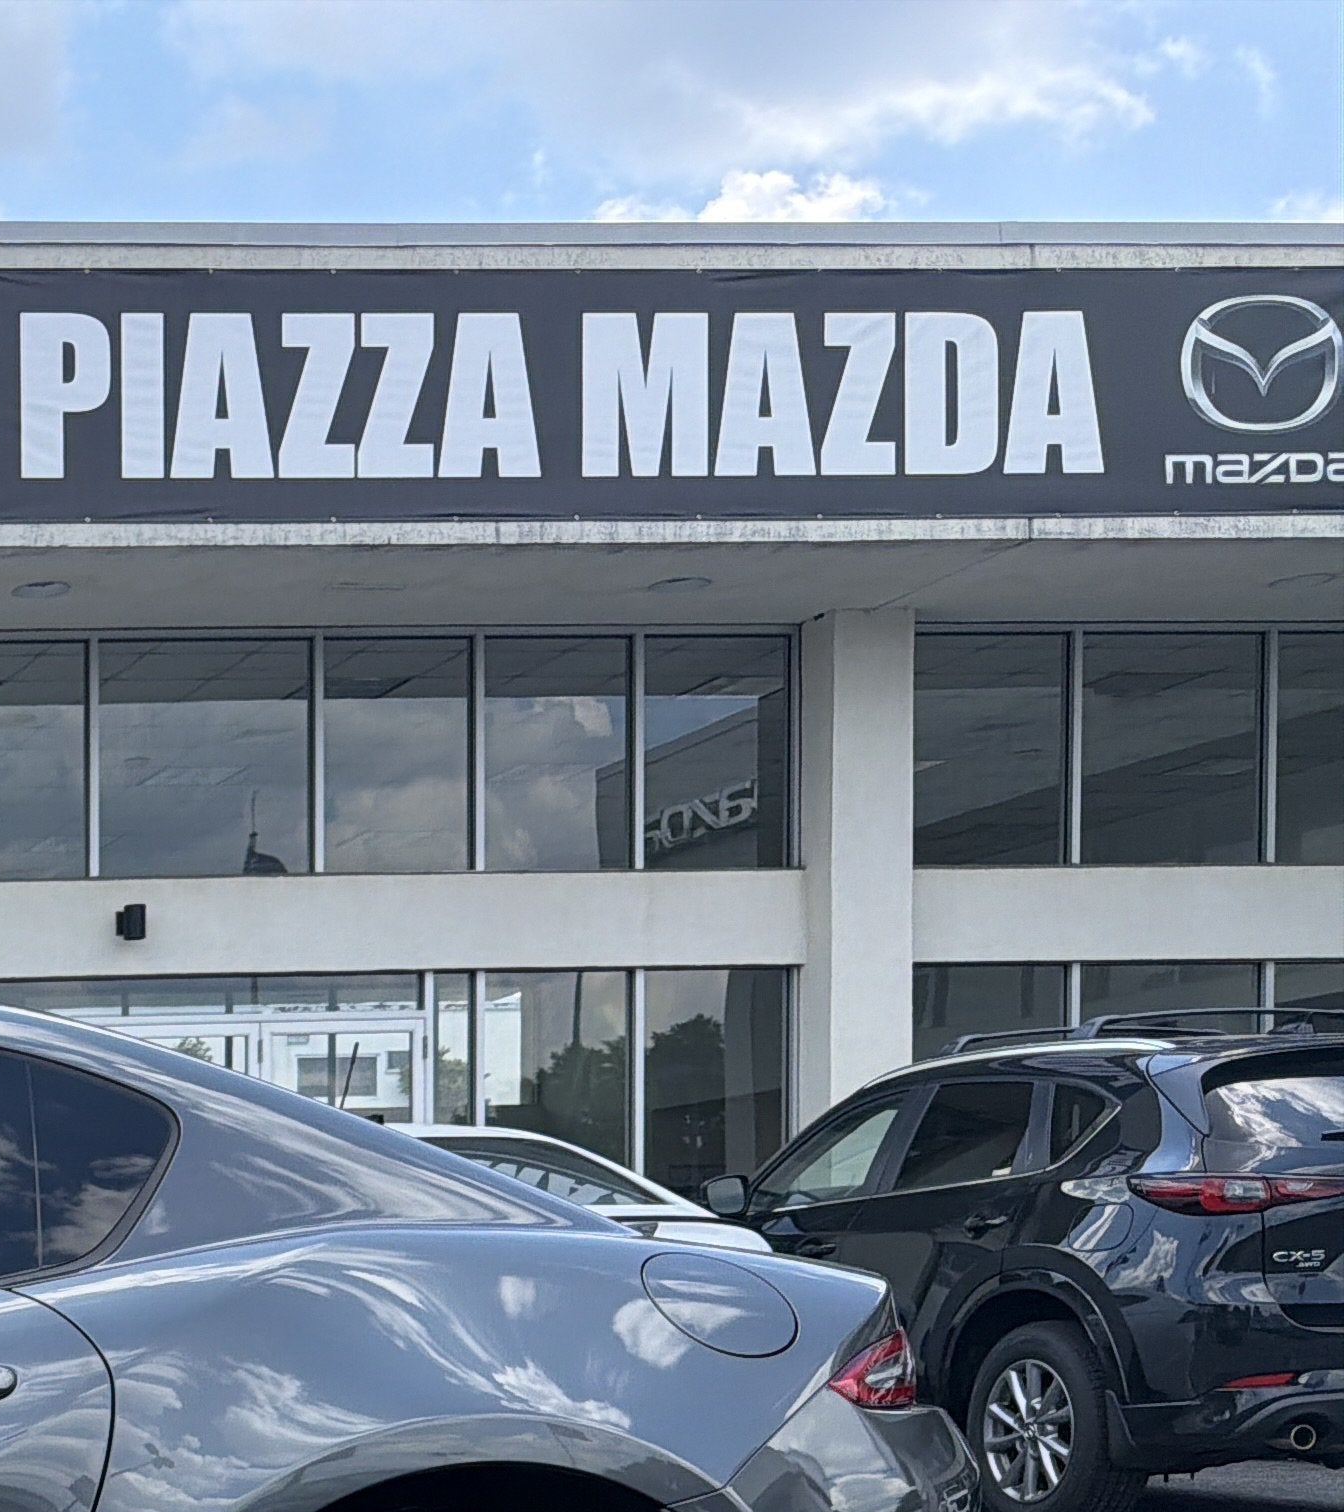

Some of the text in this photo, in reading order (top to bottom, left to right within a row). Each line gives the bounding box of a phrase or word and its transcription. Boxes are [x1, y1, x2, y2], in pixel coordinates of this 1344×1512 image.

[19, 310, 1106, 480] PIAZZA MAZDA
[1272, 1249, 1326, 1263] CX-5
